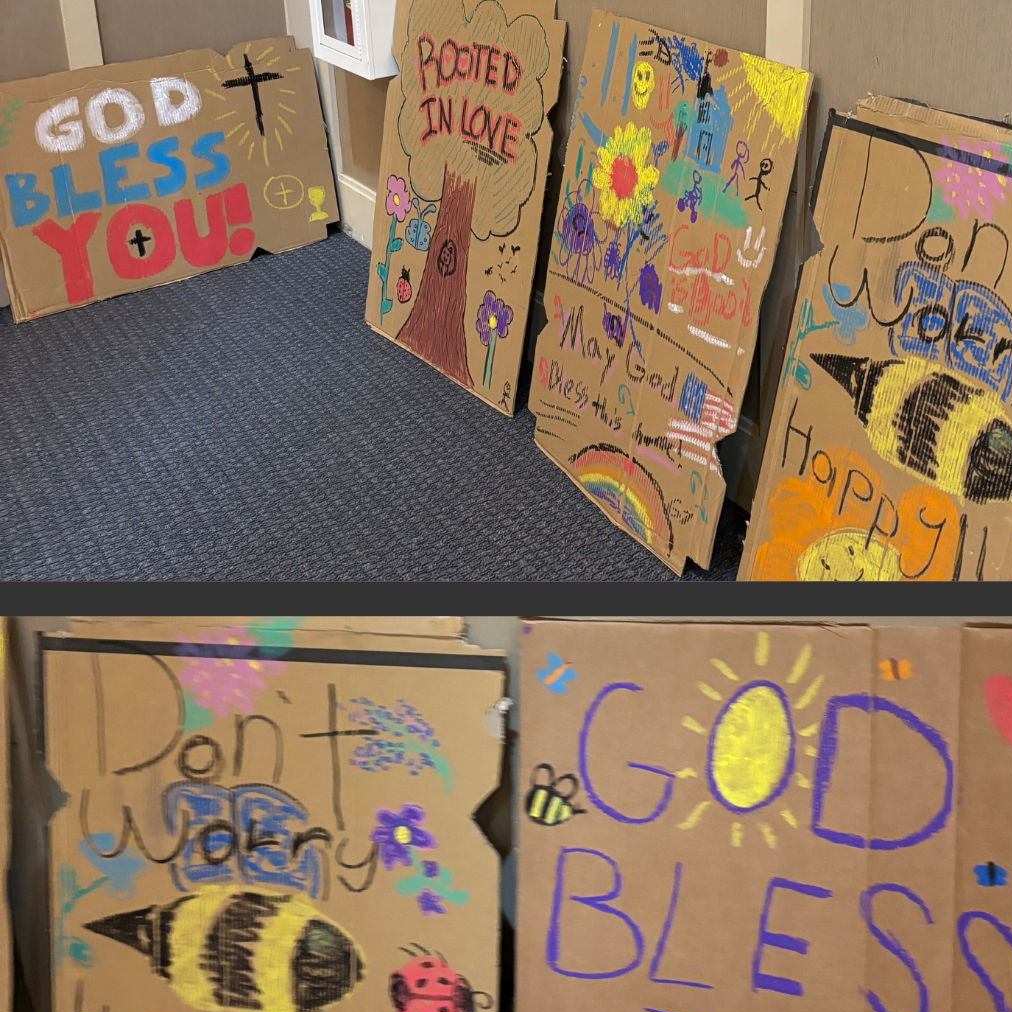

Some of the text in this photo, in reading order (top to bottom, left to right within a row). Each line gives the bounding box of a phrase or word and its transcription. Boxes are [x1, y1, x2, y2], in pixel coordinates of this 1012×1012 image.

[416, 33, 522, 95] ROOTED
[35, 76, 203, 154] GOD
[419, 96, 521, 163] IN LOVE
[4, 131, 232, 228] BLESS
[32, 183, 256, 305] YOU!
[560, 304, 680, 402] May God
[91, 641, 379, 830] Don't
[578, 680, 955, 850] GOD
